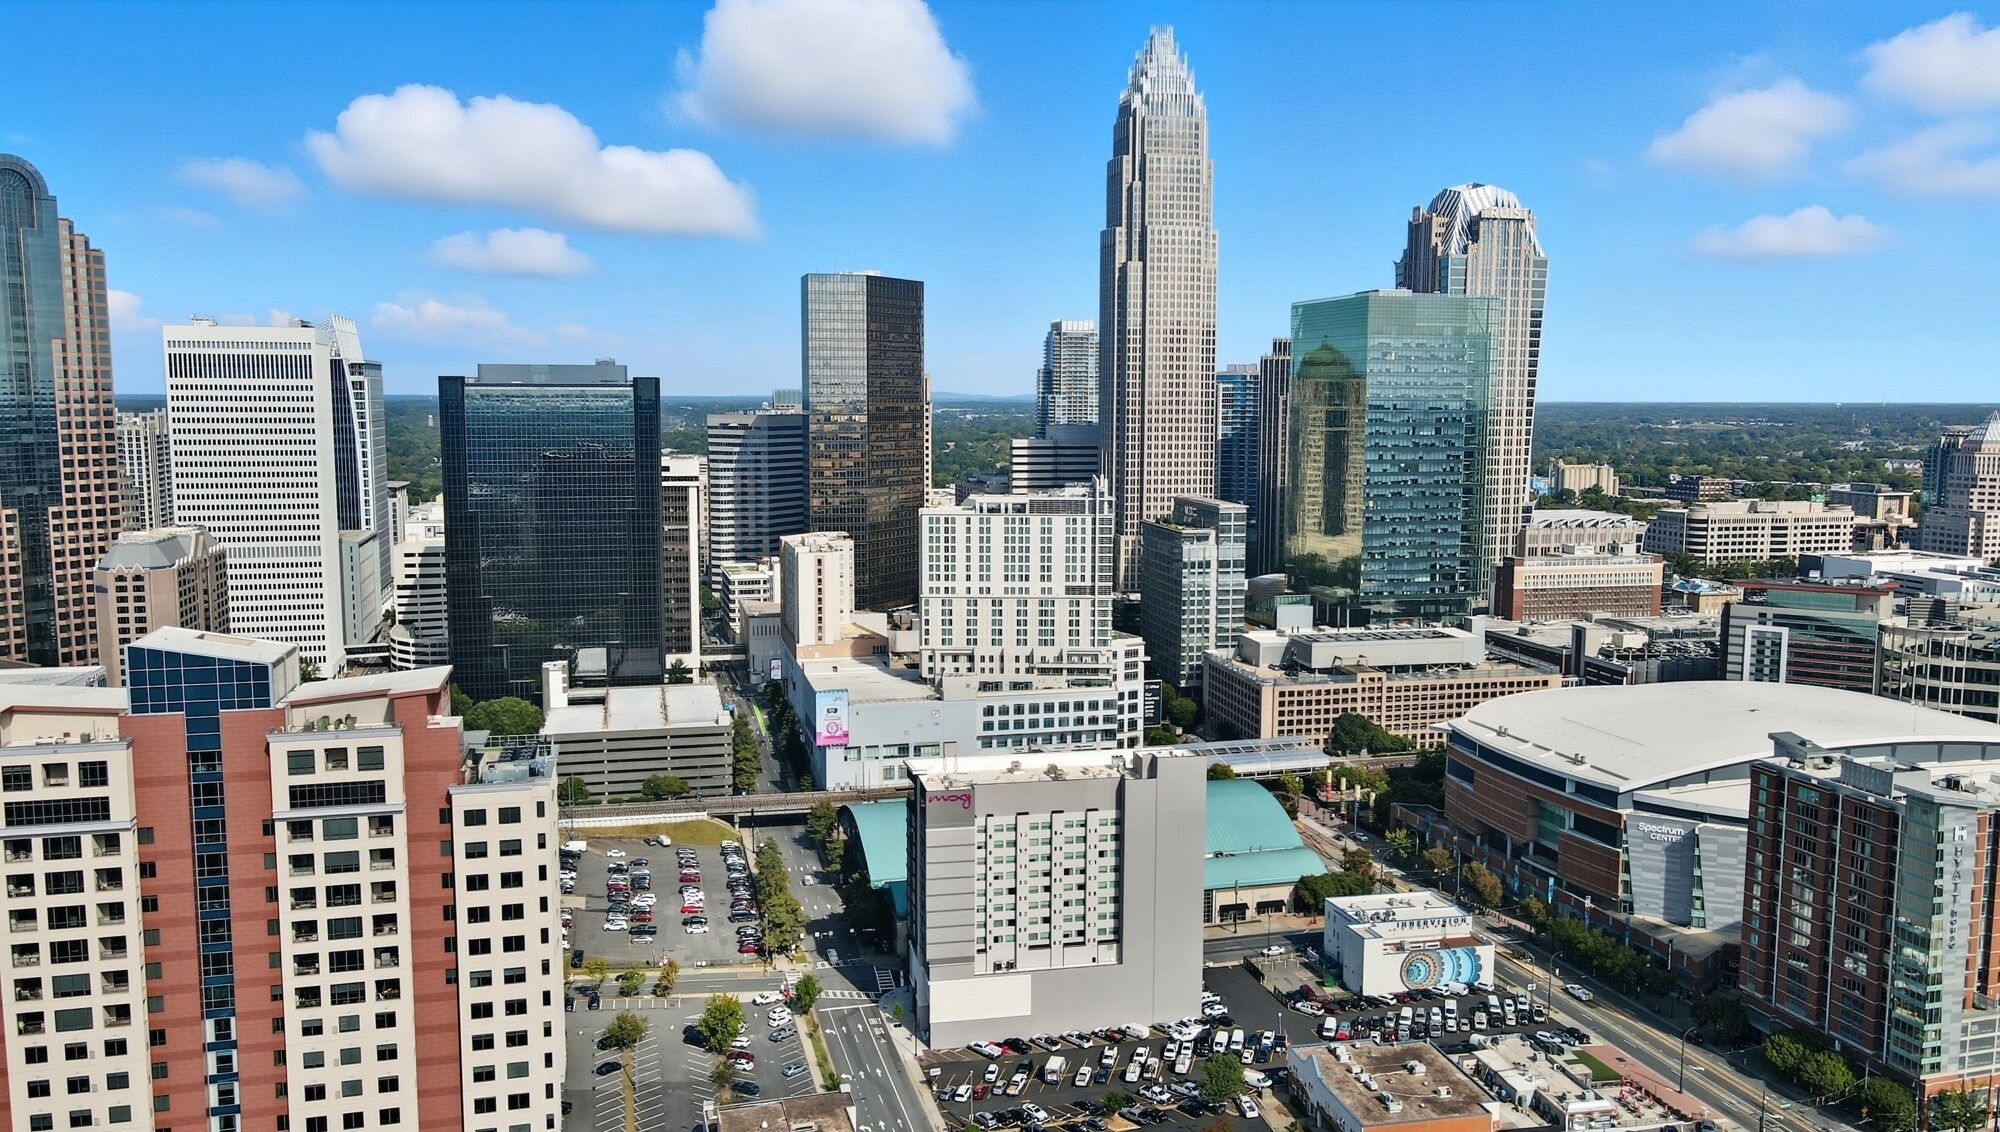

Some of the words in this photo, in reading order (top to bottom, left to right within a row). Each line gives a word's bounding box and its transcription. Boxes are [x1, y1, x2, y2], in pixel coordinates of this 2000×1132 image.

[1481, 206, 1529, 220] TRUST
[1638, 822, 1684, 836] Spectrum
[1650, 832, 1684, 843] CENTER
[1952, 846, 1963, 909] HYATT
[1396, 917, 1467, 929] INNERVISION
